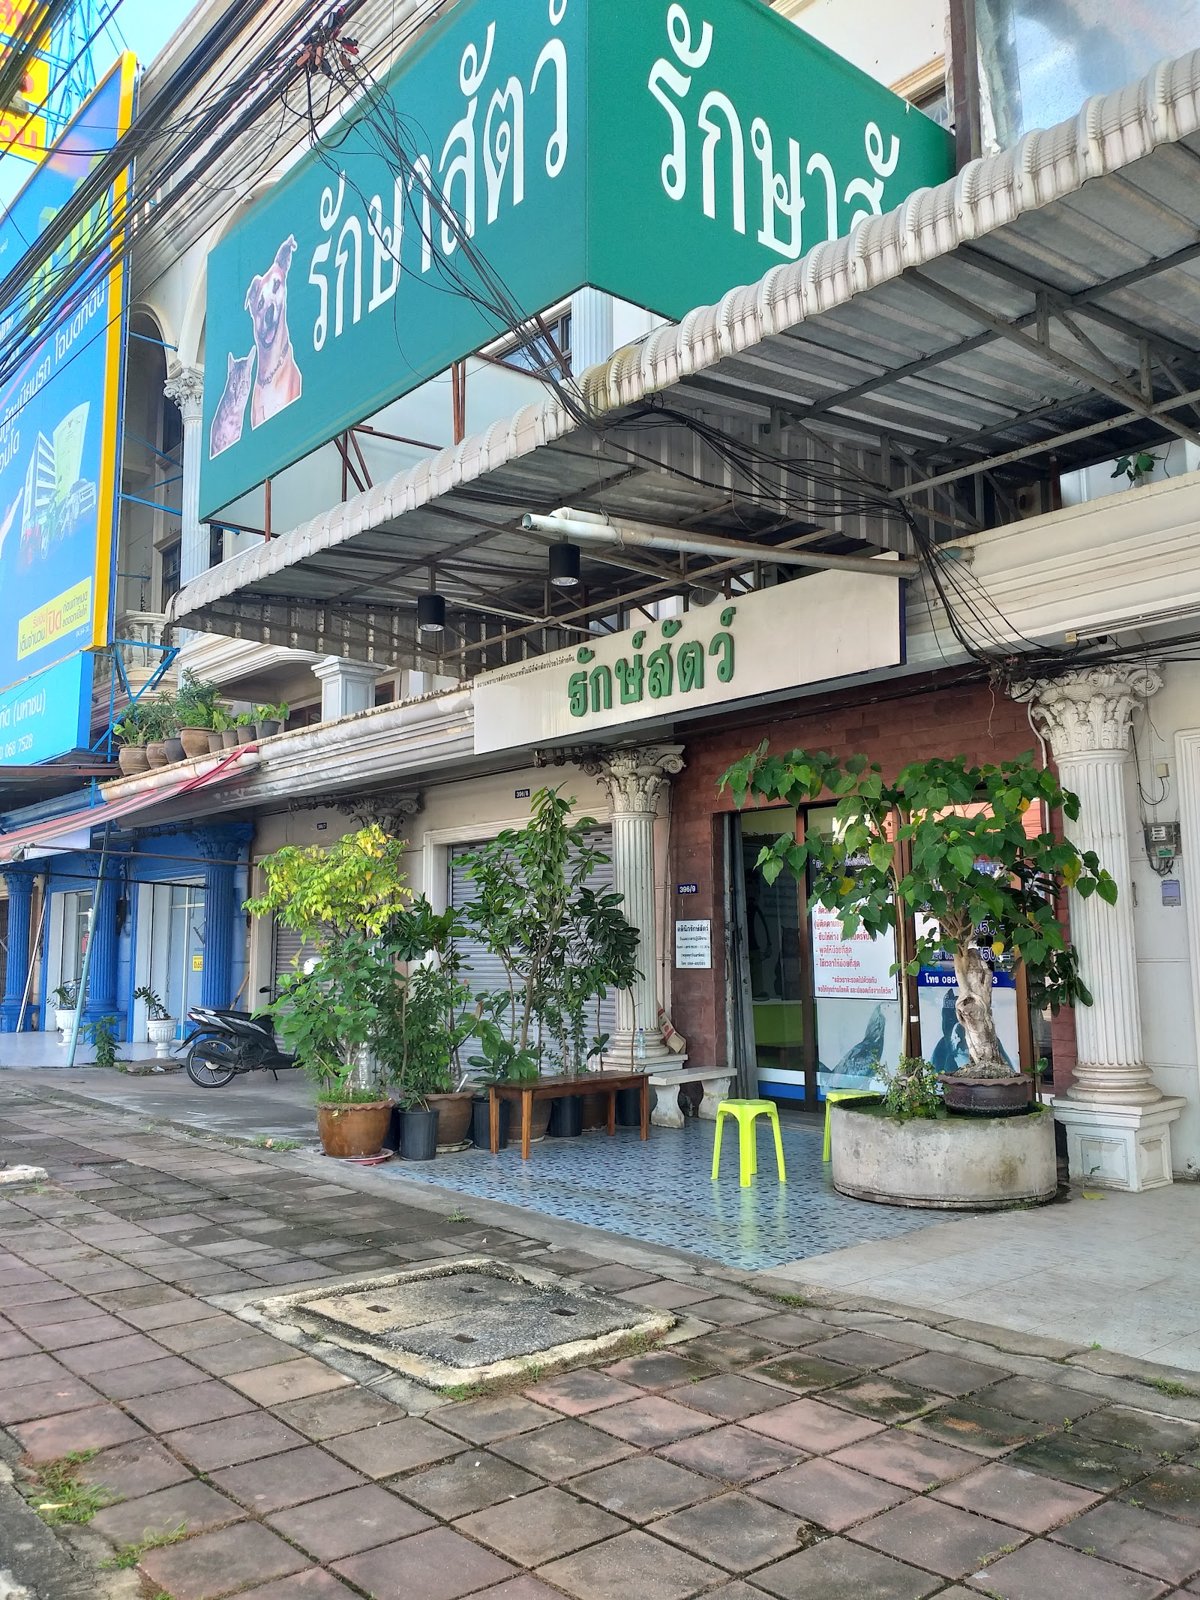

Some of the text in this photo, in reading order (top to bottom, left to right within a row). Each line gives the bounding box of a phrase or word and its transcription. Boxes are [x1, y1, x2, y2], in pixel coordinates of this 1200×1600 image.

[54, 278, 105, 365] โฉนดทีดิน
[567, 606, 736, 717] รักษ์สัตว์
[679, 885, 696, 893] 396/9
